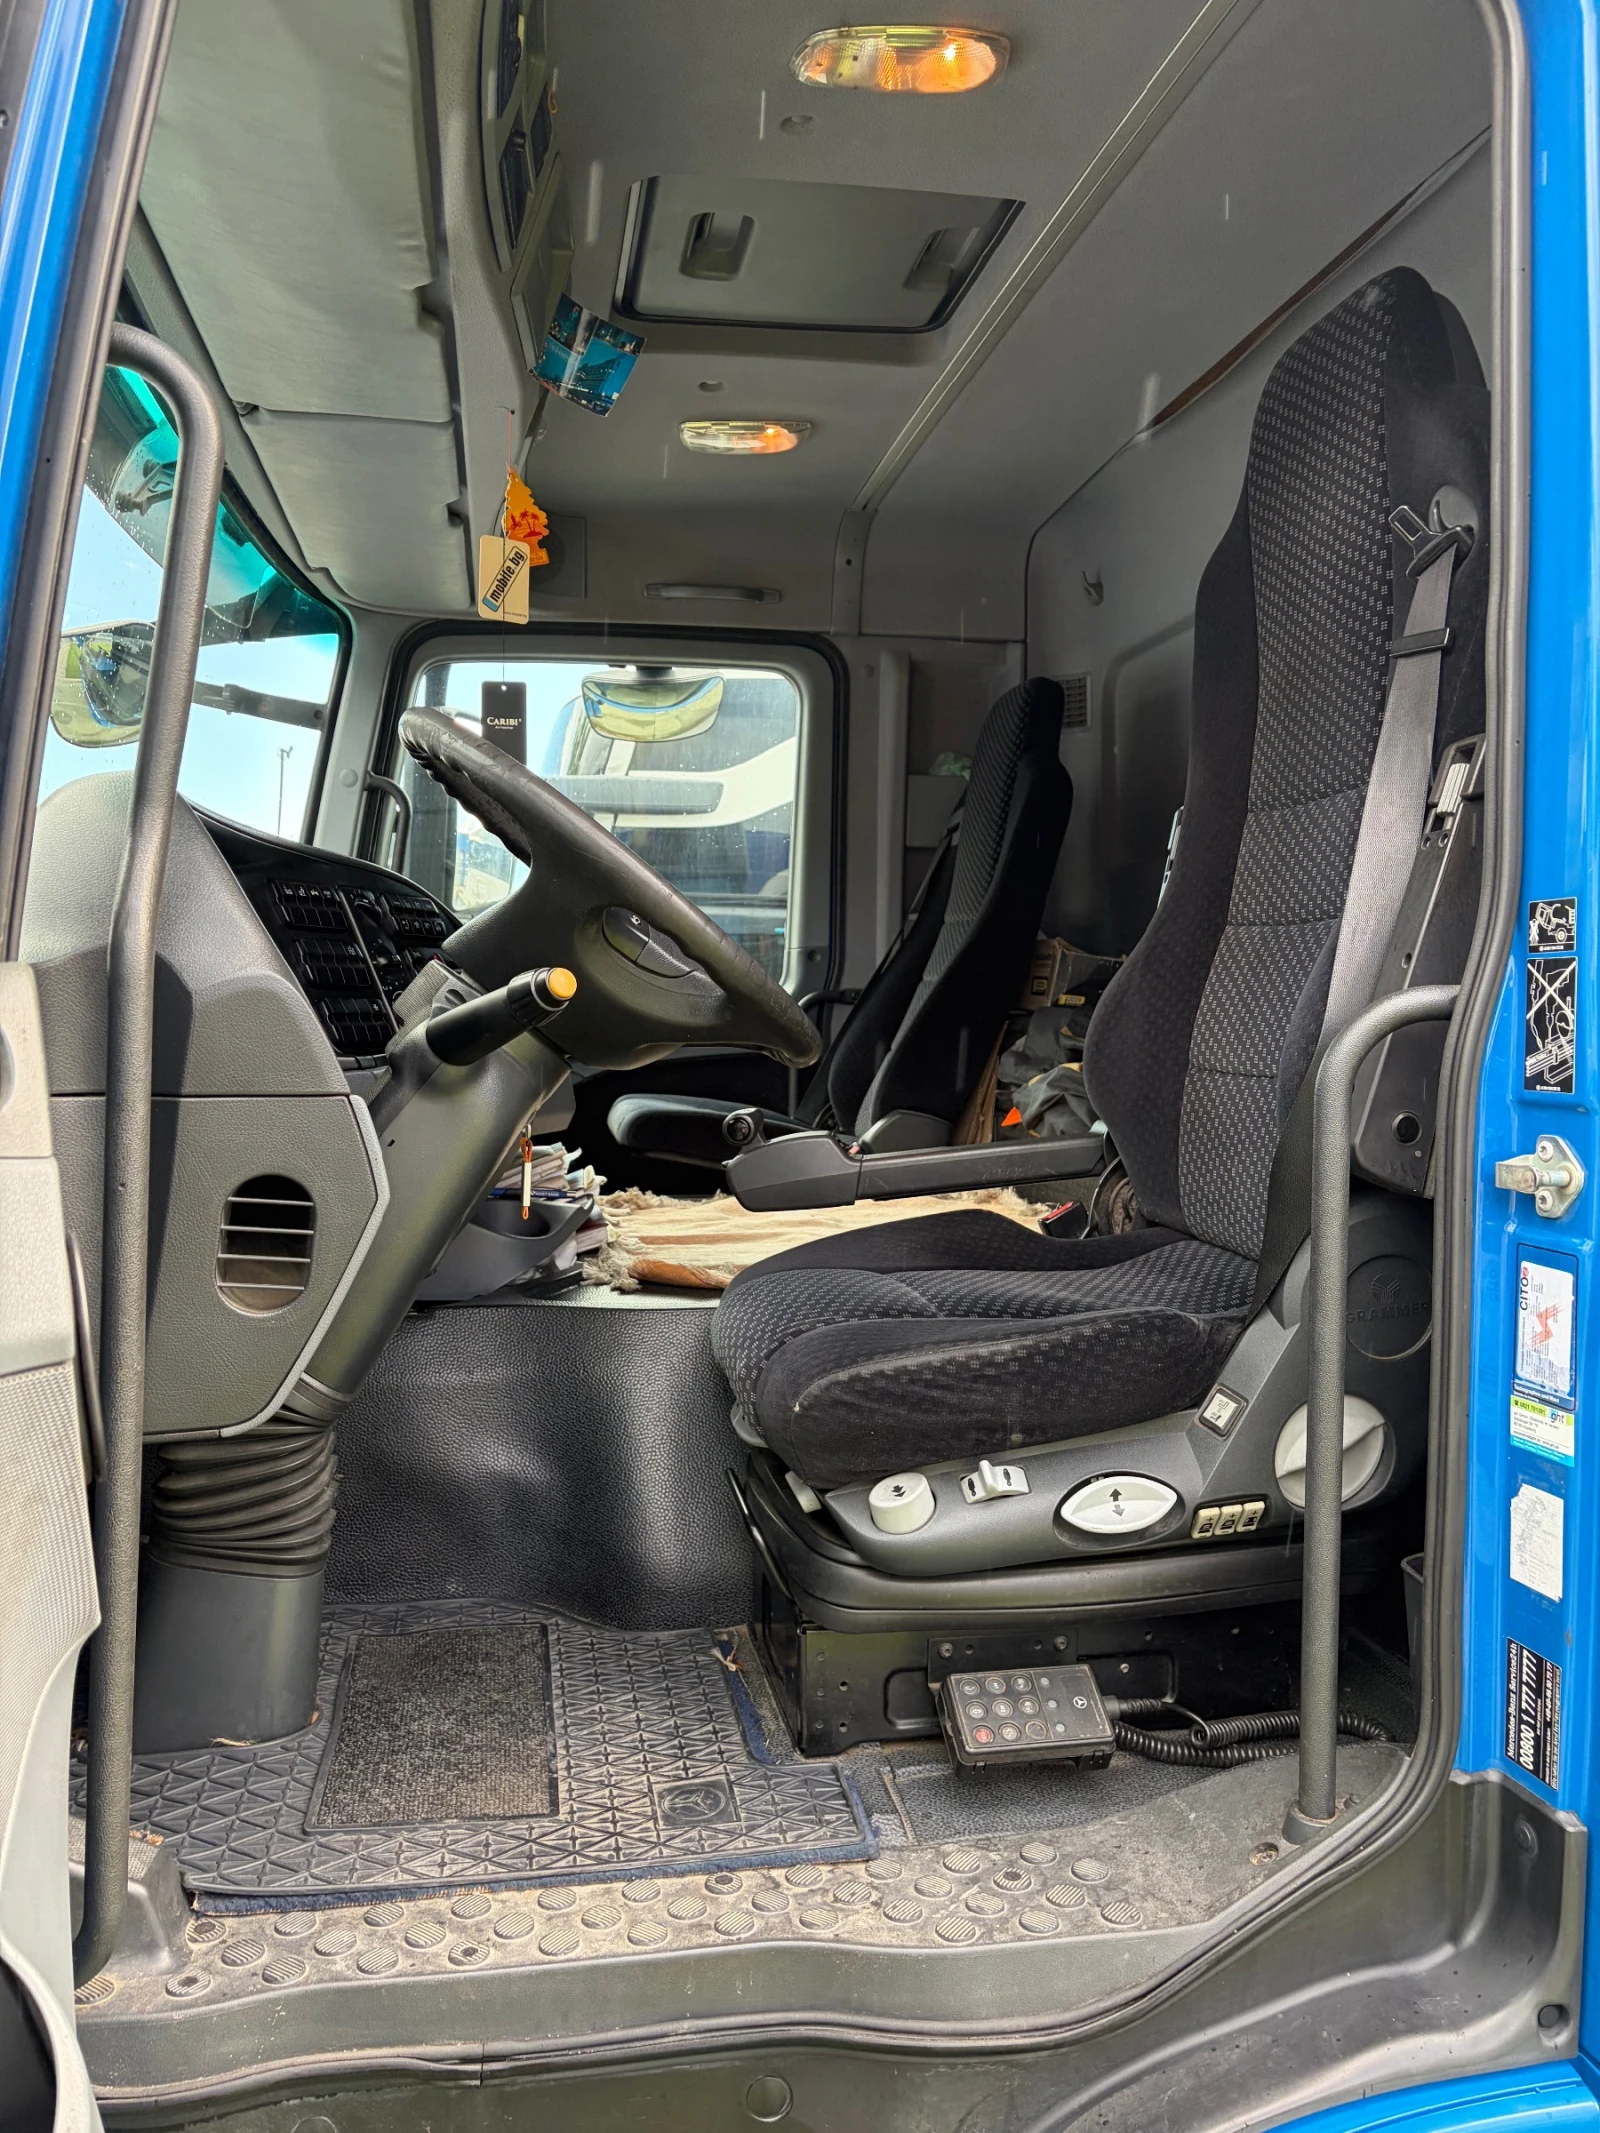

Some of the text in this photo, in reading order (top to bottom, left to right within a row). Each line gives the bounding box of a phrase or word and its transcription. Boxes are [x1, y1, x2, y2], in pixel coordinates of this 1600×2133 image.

[1520, 1276, 1529, 1311] CITO
[1507, 1643, 1517, 1760] Mercedes-Benz Service24h
[1520, 1649, 1537, 1771] 00800 1 777 7777
